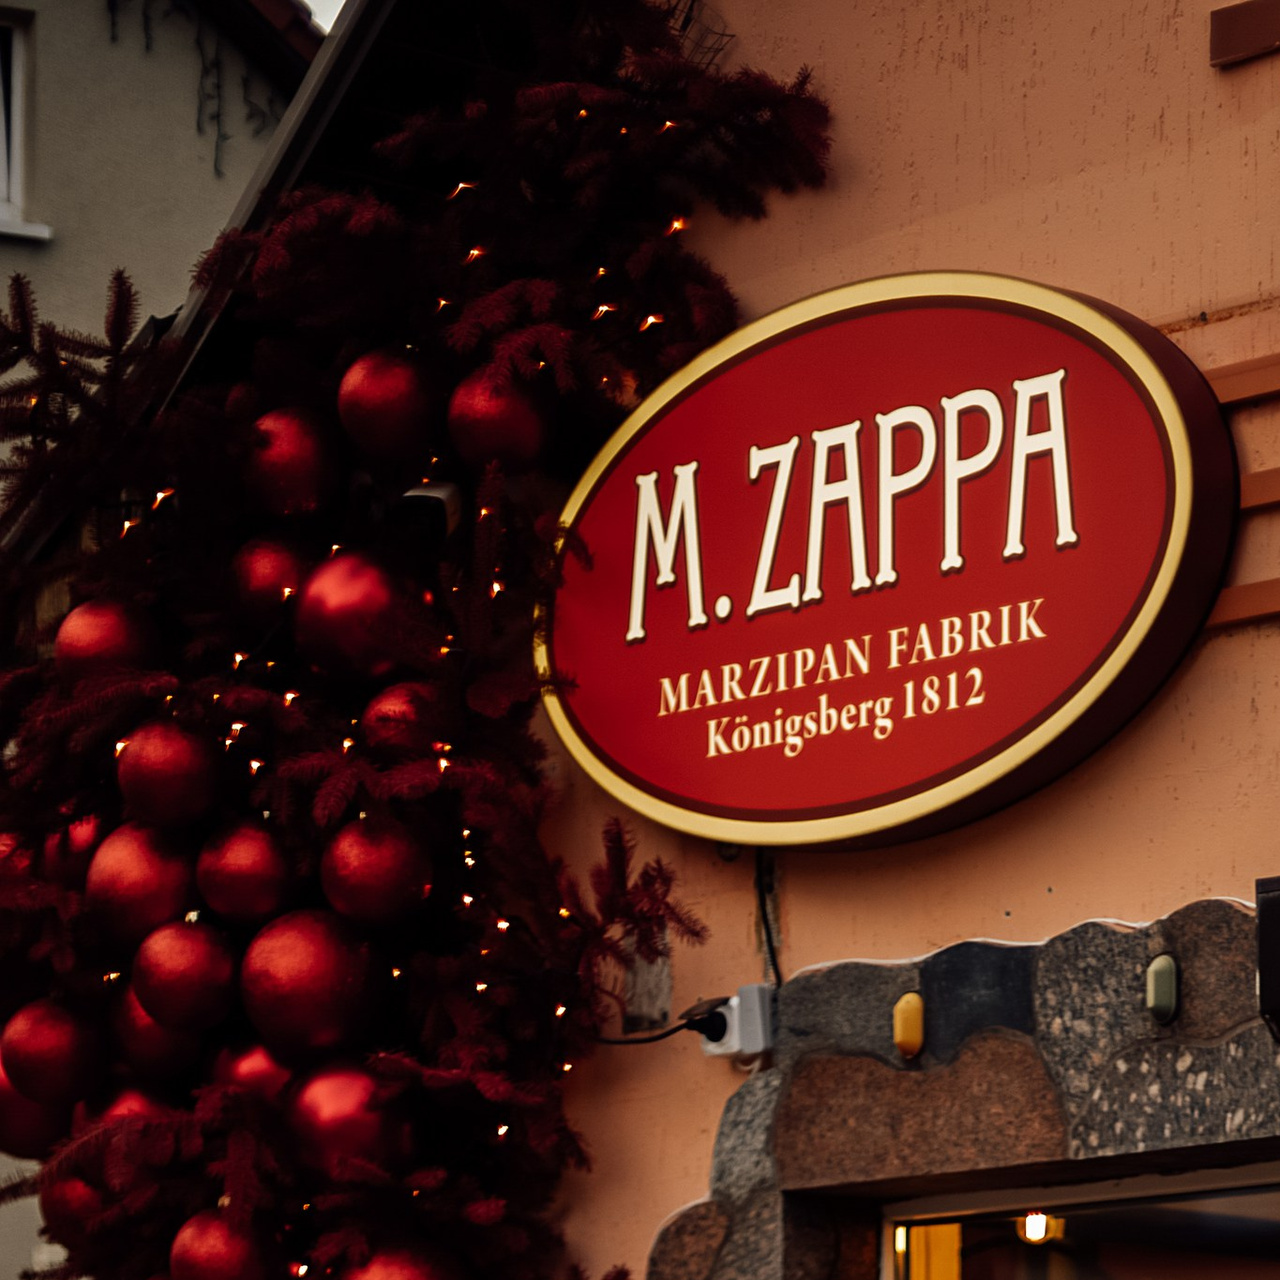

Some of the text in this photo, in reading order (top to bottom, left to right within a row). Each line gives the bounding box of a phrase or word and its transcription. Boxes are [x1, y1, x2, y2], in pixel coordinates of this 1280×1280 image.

[656, 598, 1047, 717] MARZIPAN FABRIK
[705, 666, 988, 758] Königsberg 1812
